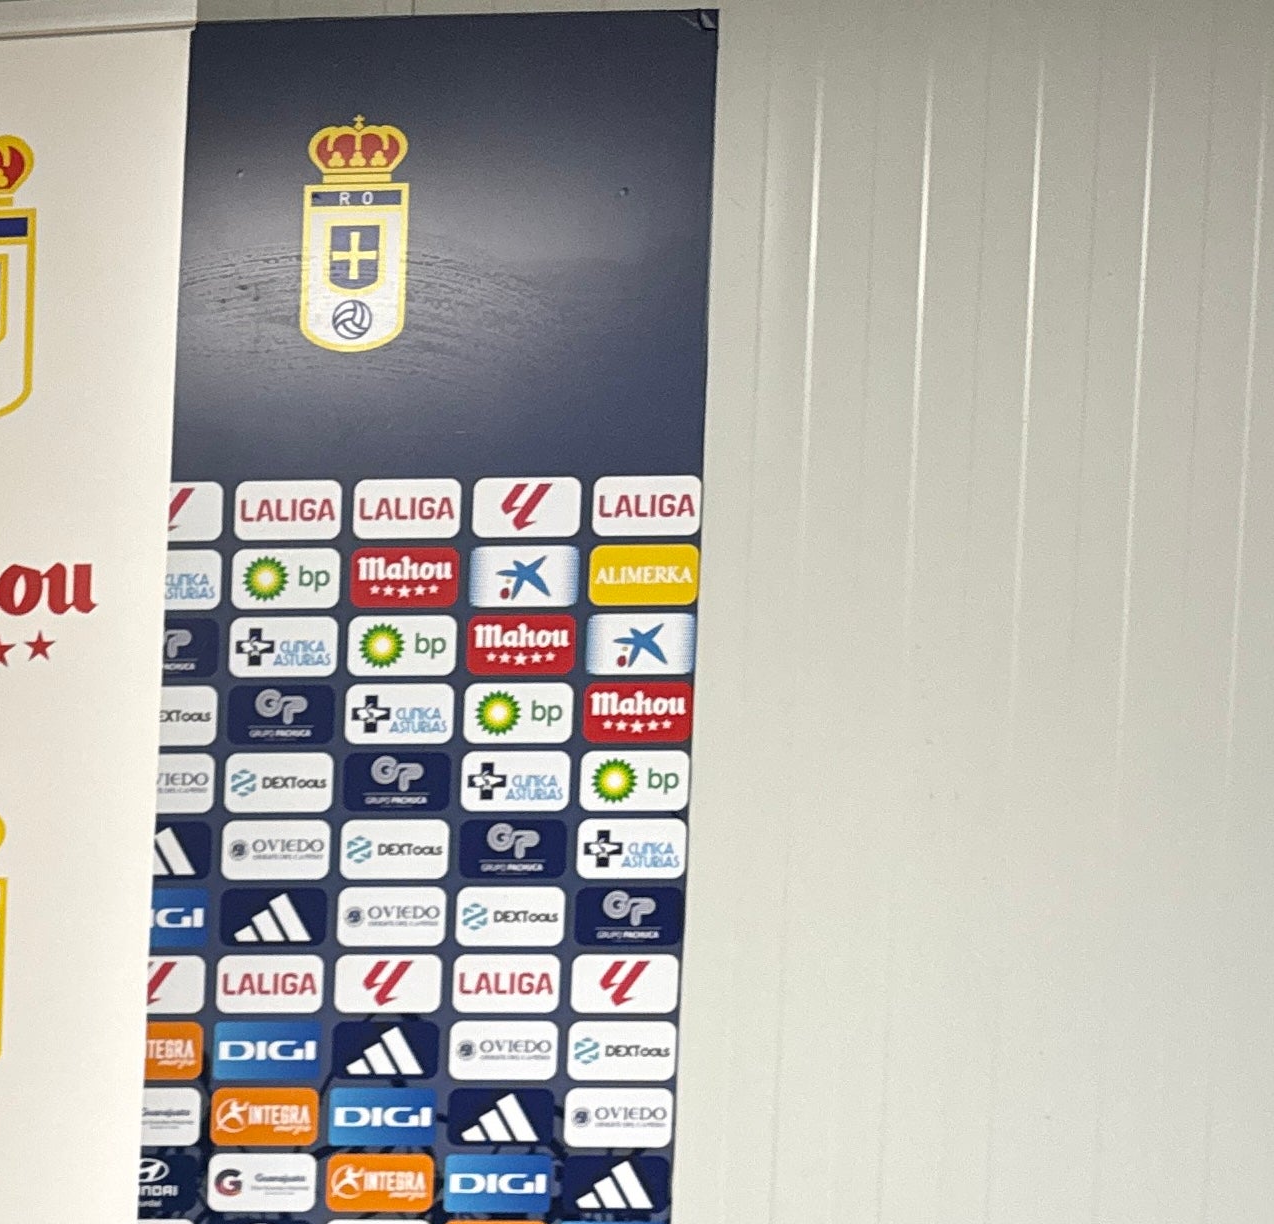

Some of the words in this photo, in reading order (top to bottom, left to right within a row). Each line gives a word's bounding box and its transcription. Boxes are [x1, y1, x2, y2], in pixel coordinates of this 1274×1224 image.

[241, 499, 335, 522] LALIGA
[360, 497, 454, 520] LALIGA
[599, 494, 695, 518] LALIGA
[299, 565, 330, 592] bp
[358, 556, 452, 580] Mahou
[595, 566, 692, 584] ALIMERKA
[415, 633, 446, 659] bp
[474, 623, 569, 648] Mahou
[531, 700, 562, 726] bp
[591, 691, 686, 715] Mahou
[648, 768, 679, 794] bp
[253, 838, 324, 853] OVIEDO
[368, 904, 439, 919] OVIEDO
[223, 973, 316, 995] LALIGA
[459, 972, 553, 995] LALIGA
[149, 1040, 194, 1060] TEGRA
[218, 1041, 316, 1060] DIGI
[480, 1039, 551, 1054] OVIEDO
[249, 1106, 310, 1126] INTEGRA
[334, 1107, 431, 1127] DIGI
[595, 1105, 666, 1121] OVIEDO
[364, 1173, 425, 1193] INTEGRA
[449, 1173, 546, 1193] DIGI
